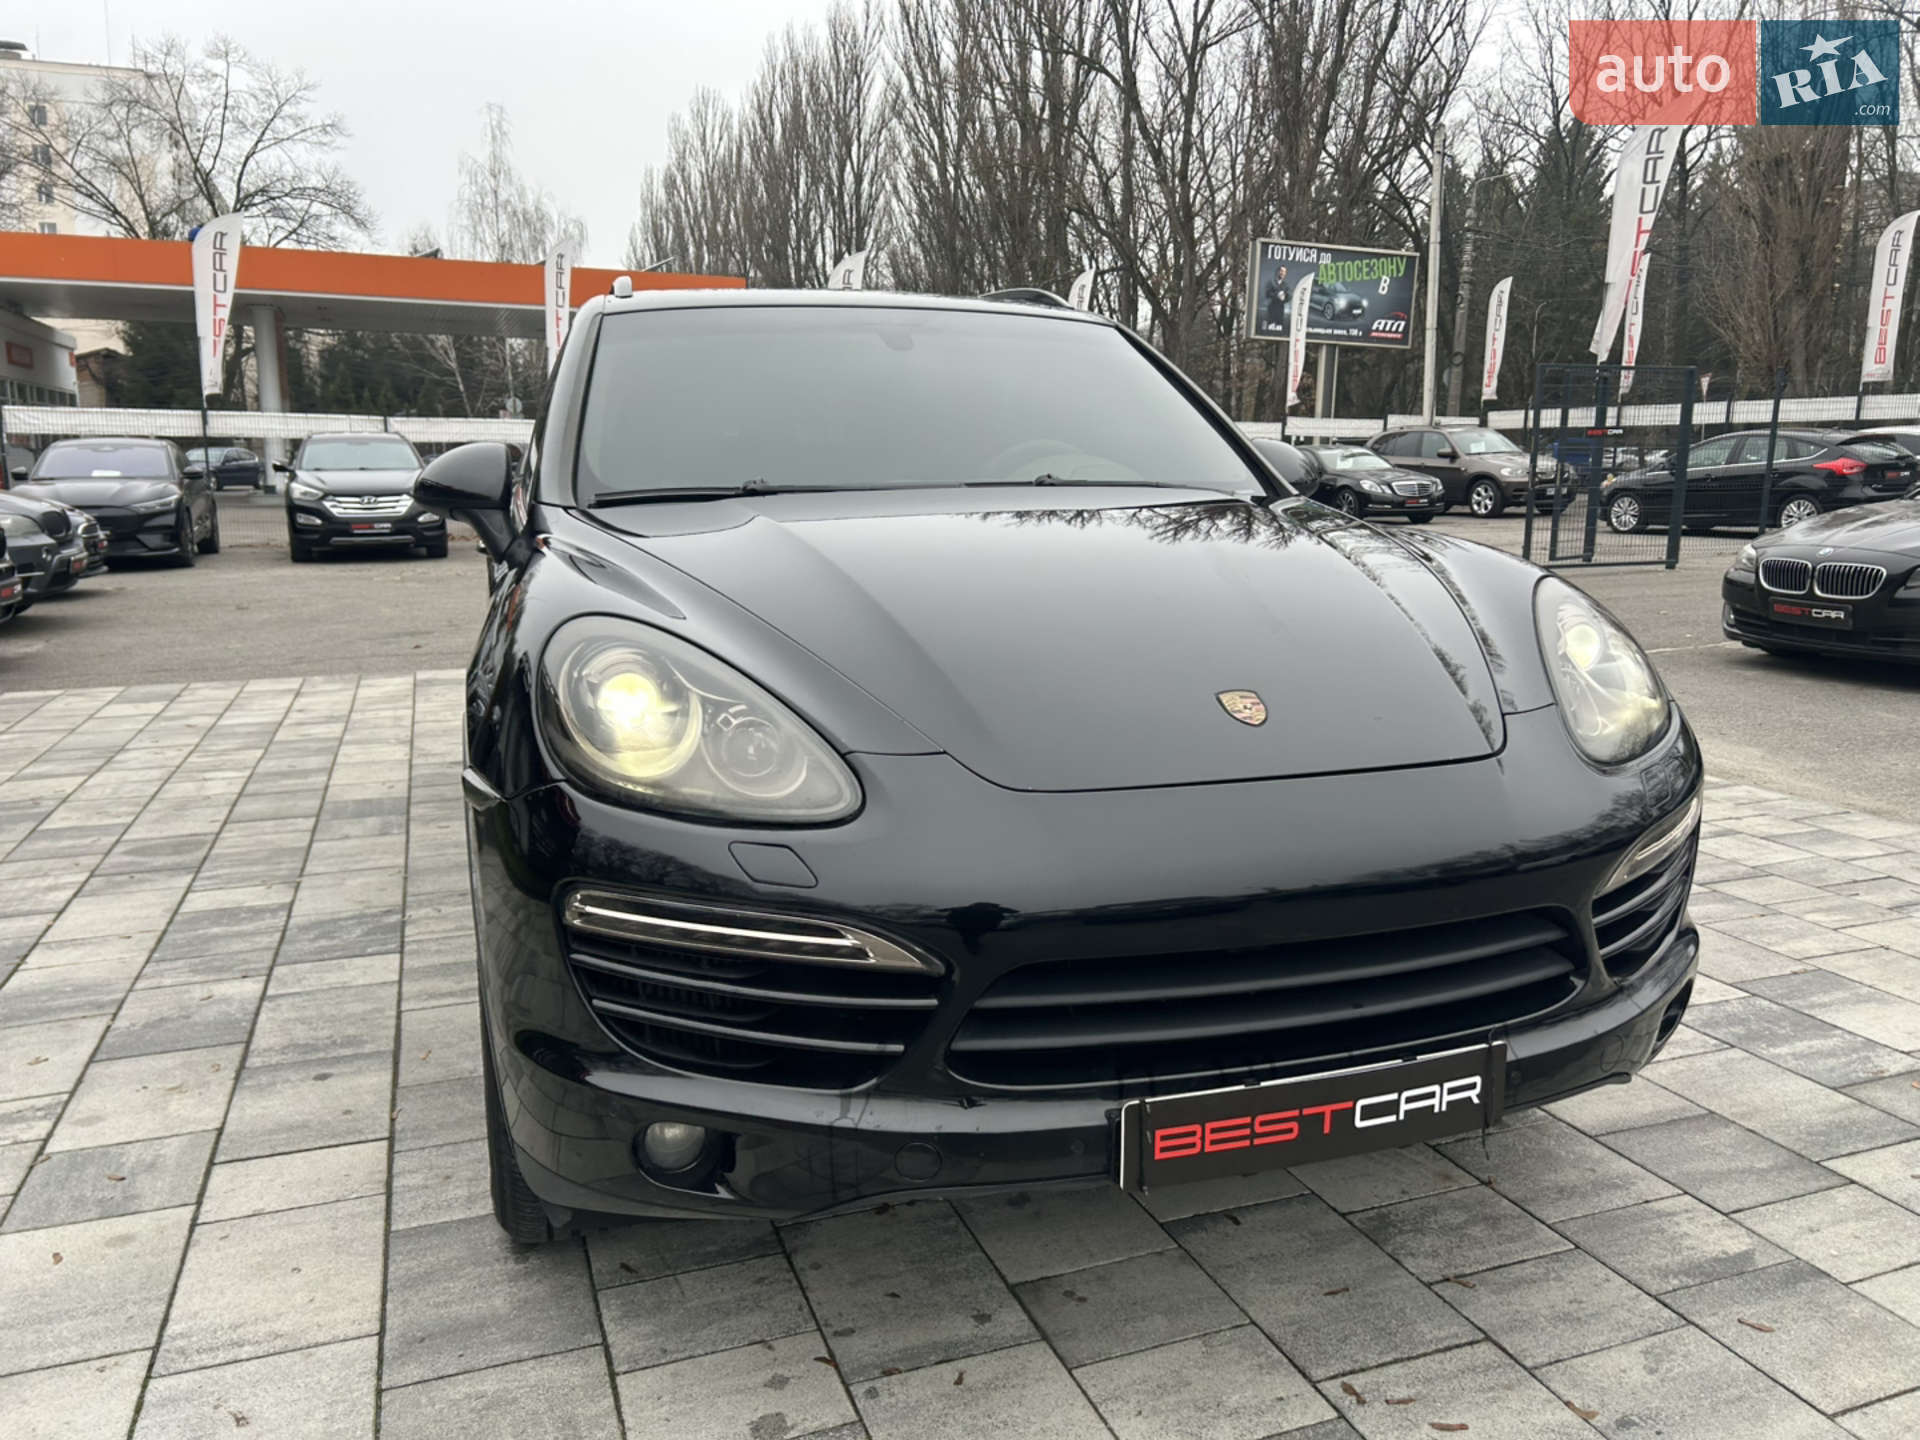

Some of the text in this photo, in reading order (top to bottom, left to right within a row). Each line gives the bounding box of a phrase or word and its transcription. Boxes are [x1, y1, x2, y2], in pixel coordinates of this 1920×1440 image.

[1624, 125, 1669, 306] STCAR
[212, 231, 228, 358] STCAR
[1318, 256, 1408, 285] АВТОСЕЗОНУ
[1874, 229, 1905, 365] BESTCAR
[1371, 319, 1407, 333] АТЛ
[1154, 1075, 1482, 1160] BESTCAR
